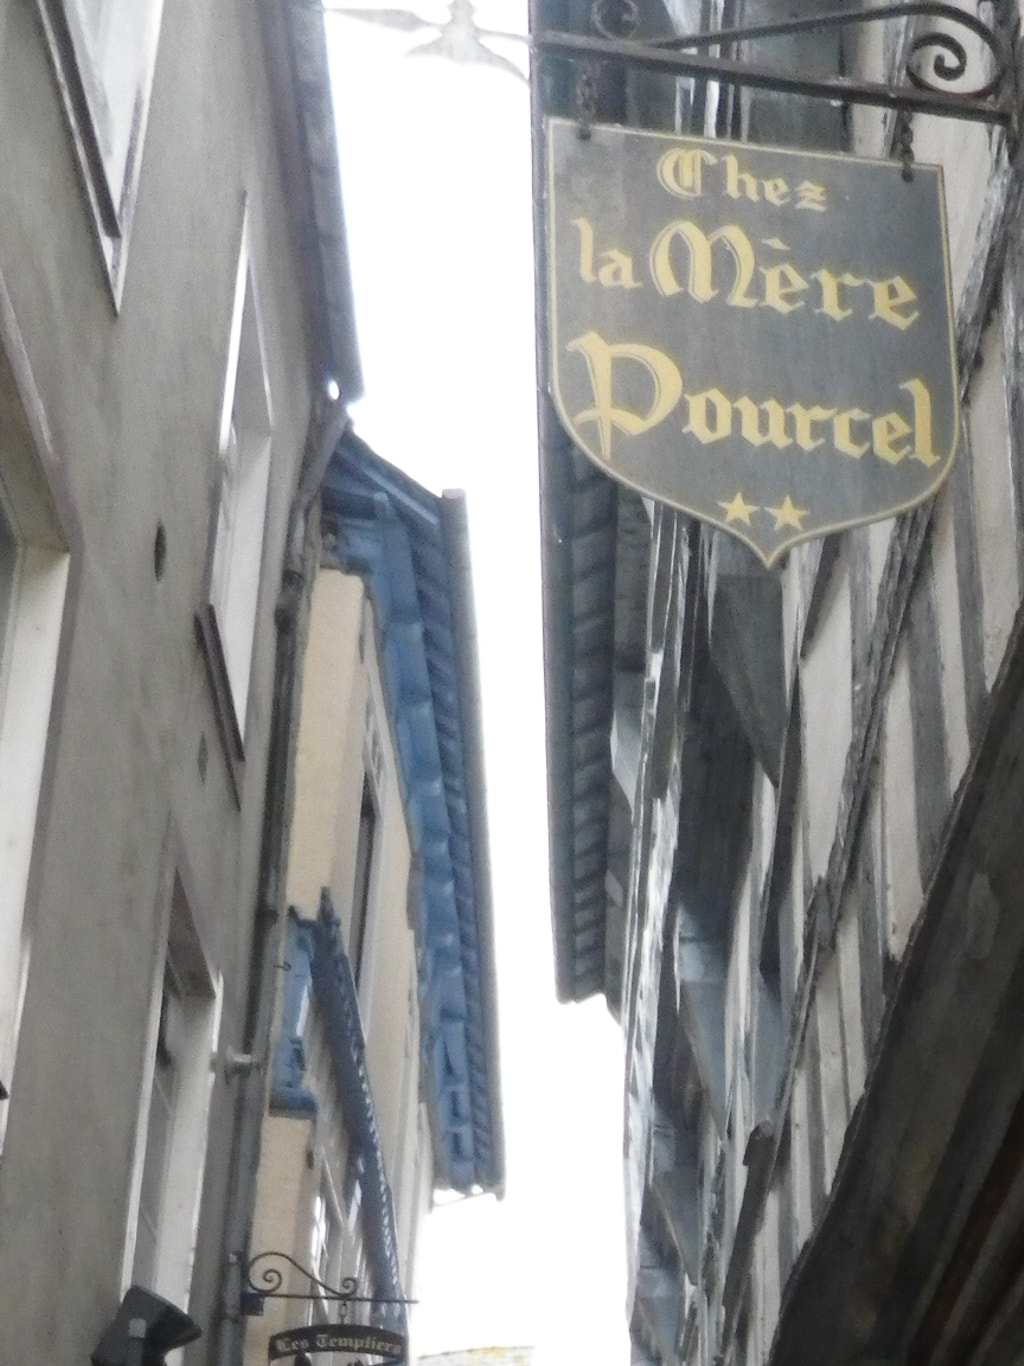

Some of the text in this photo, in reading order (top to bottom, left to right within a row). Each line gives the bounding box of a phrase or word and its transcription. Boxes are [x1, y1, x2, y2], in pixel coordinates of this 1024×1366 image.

[656, 146, 828, 213] Chez
[571, 217, 920, 330] la Mère
[566, 330, 941, 468] Pourcel
[275, 1333, 402, 1354] Les Templiers
